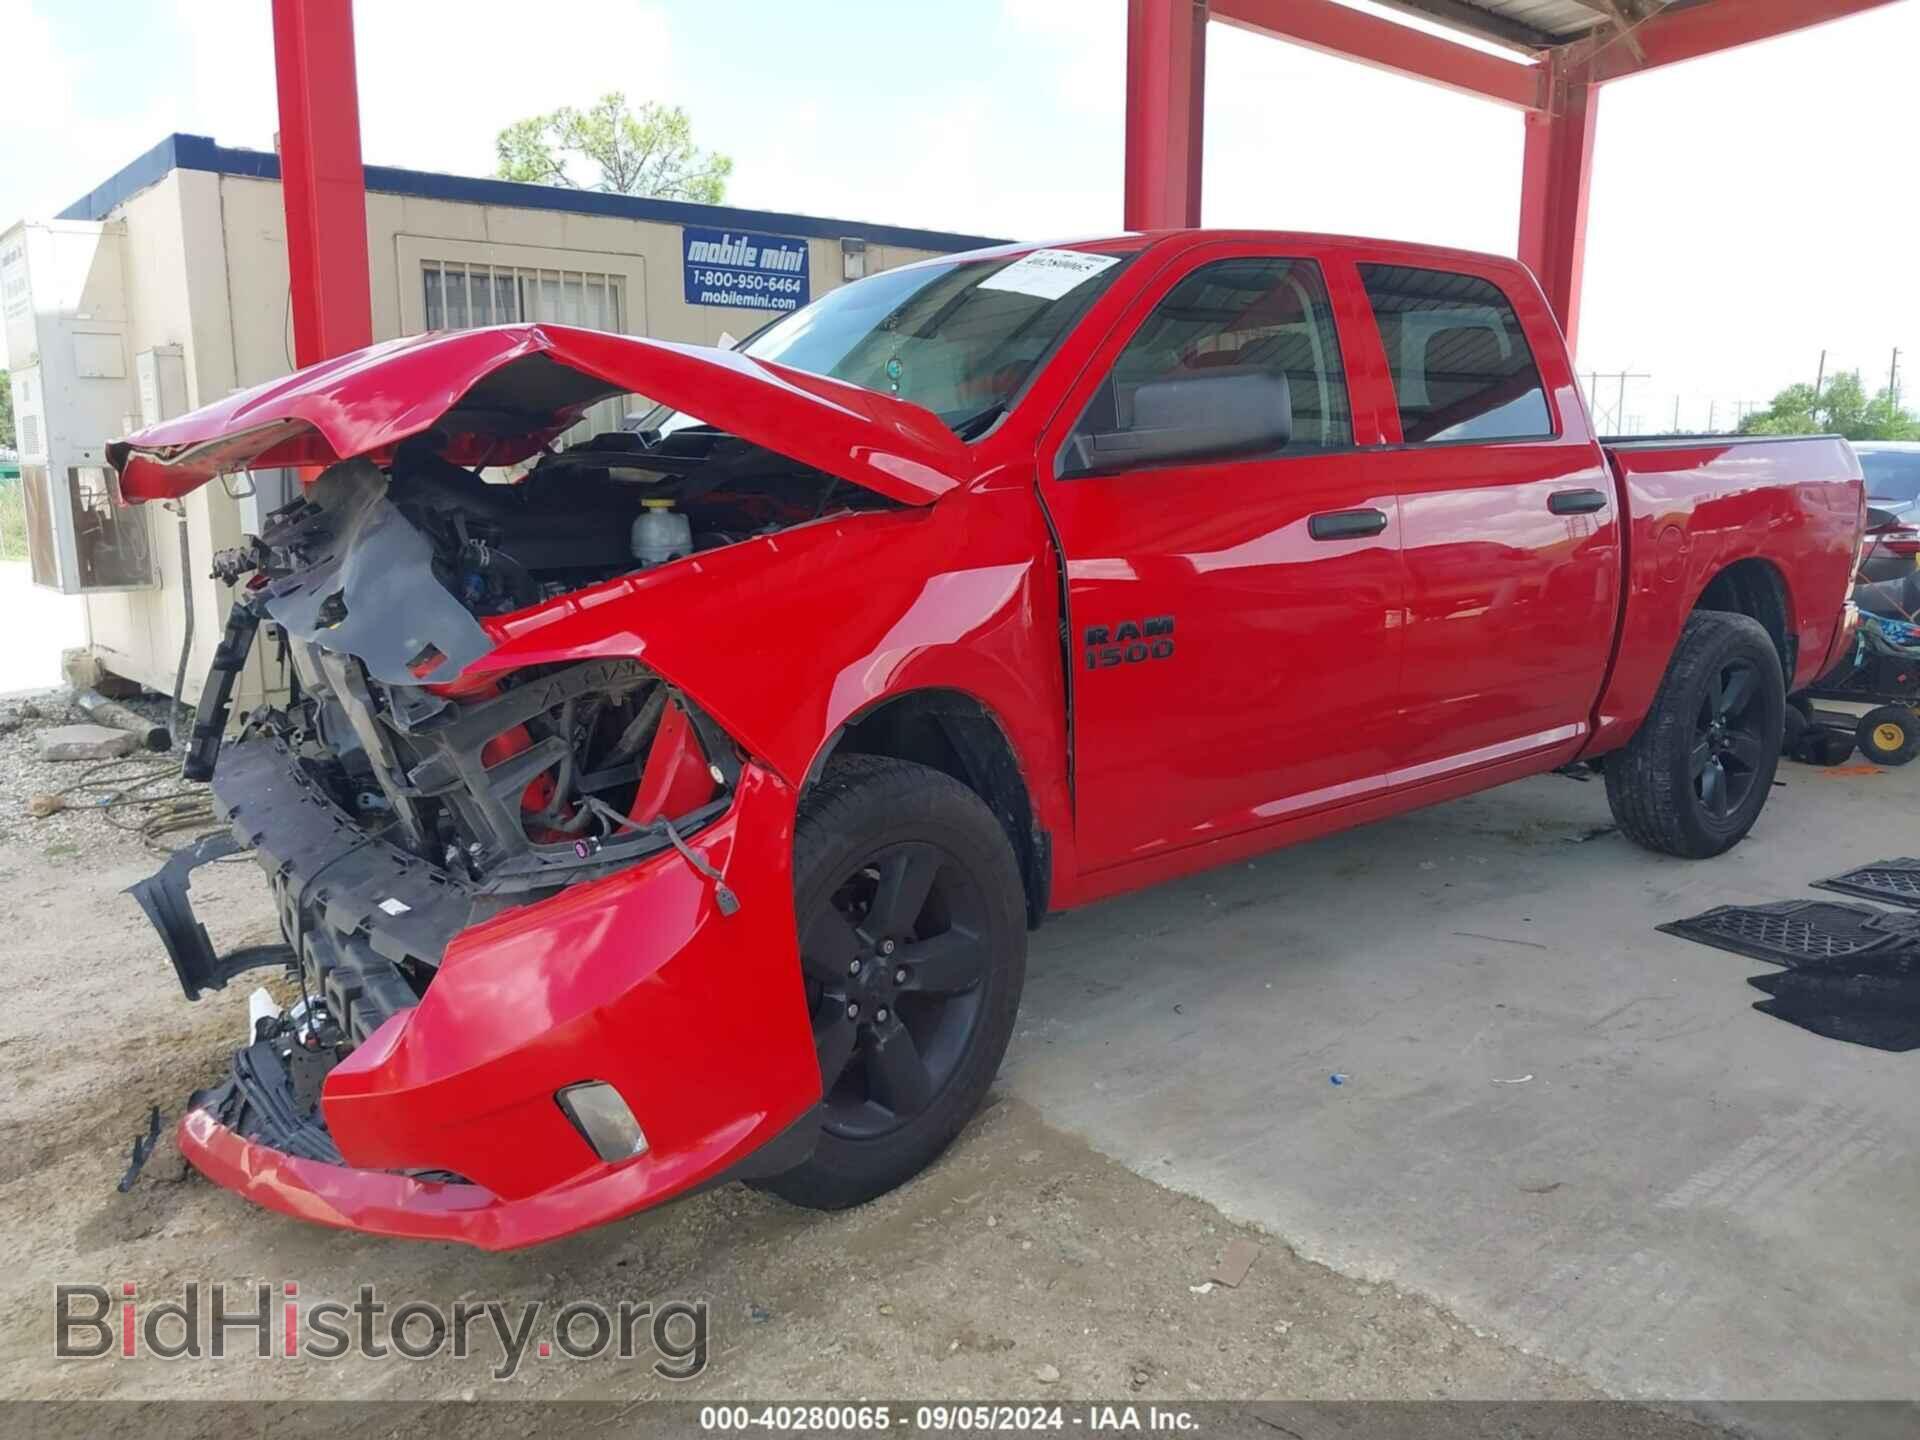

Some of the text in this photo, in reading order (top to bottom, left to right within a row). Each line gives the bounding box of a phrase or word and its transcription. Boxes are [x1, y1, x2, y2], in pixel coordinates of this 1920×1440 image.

[687, 234, 805, 272] mobile mini
[693, 270, 801, 293] 1-800-950-6464
[700, 290, 796, 309] mobilemini.com
[1086, 616, 1175, 645] RAM
[1087, 639, 1174, 669] 1500
